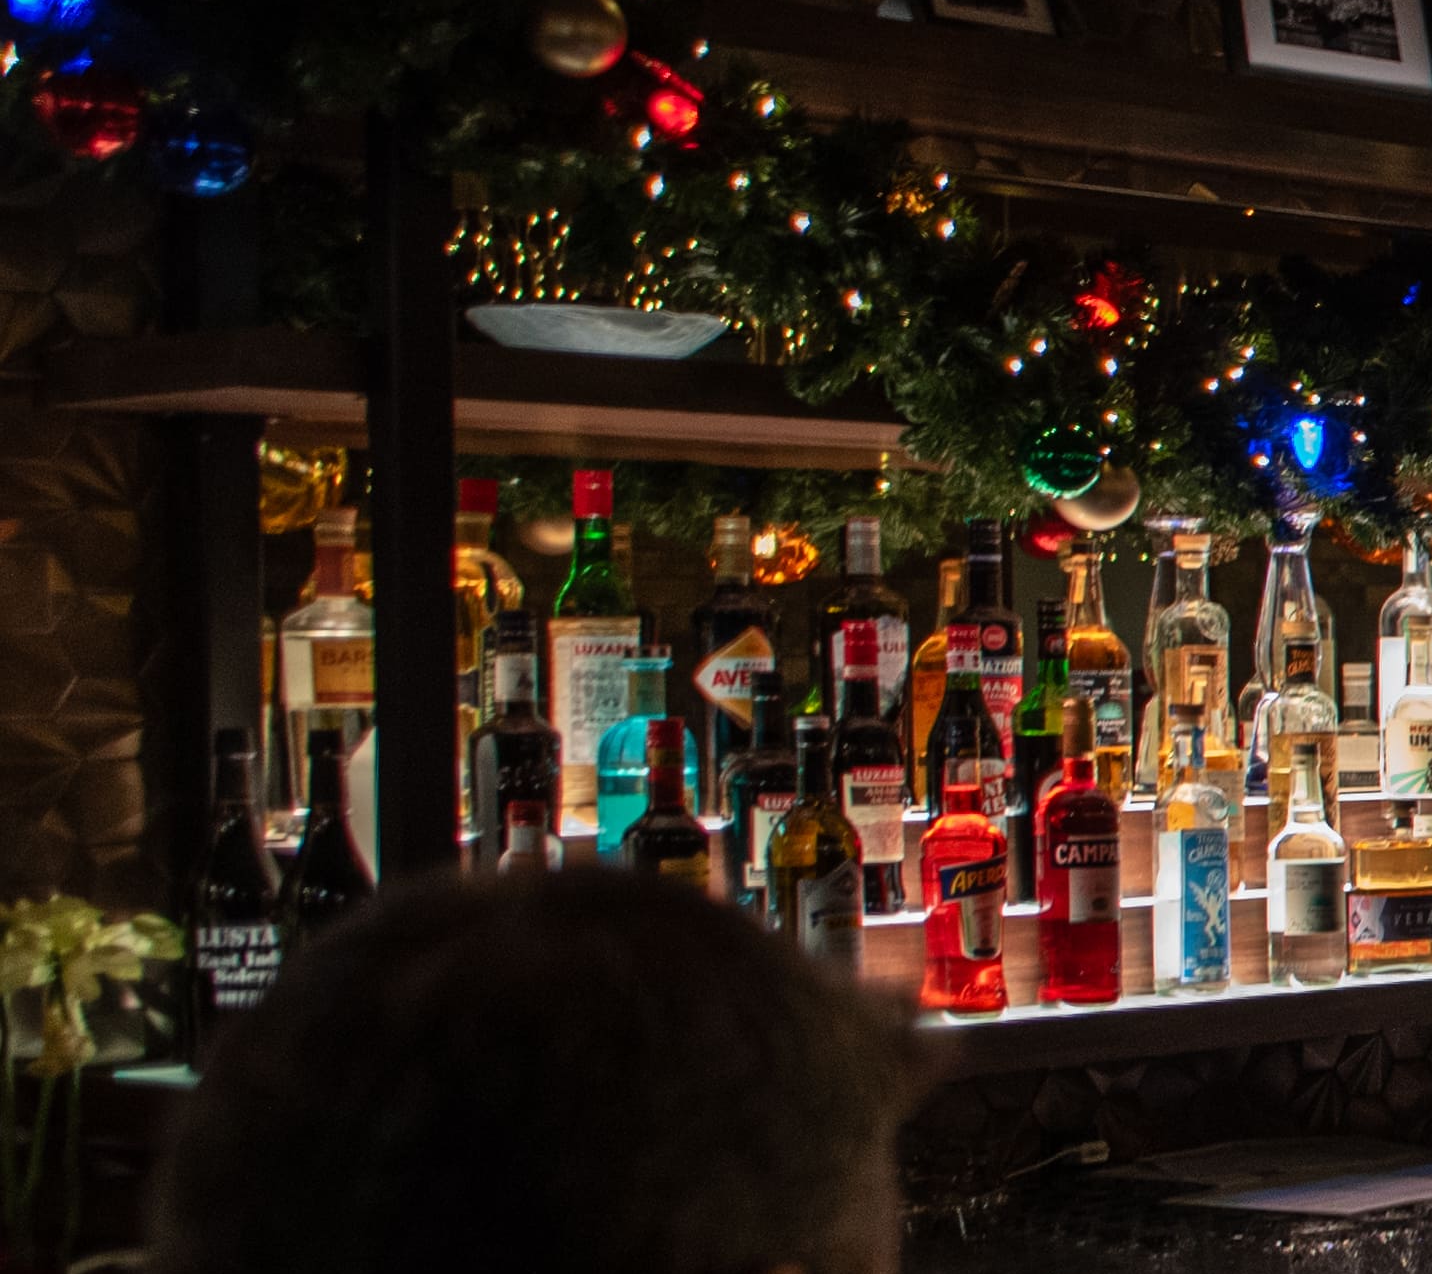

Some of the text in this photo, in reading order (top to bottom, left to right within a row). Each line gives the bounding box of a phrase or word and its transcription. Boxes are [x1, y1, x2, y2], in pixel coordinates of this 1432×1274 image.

[712, 669, 752, 687] AVE
[763, 796, 794, 812] LUX
[1055, 842, 1119, 866] CAMPA
[196, 925, 280, 949] LUSTA
